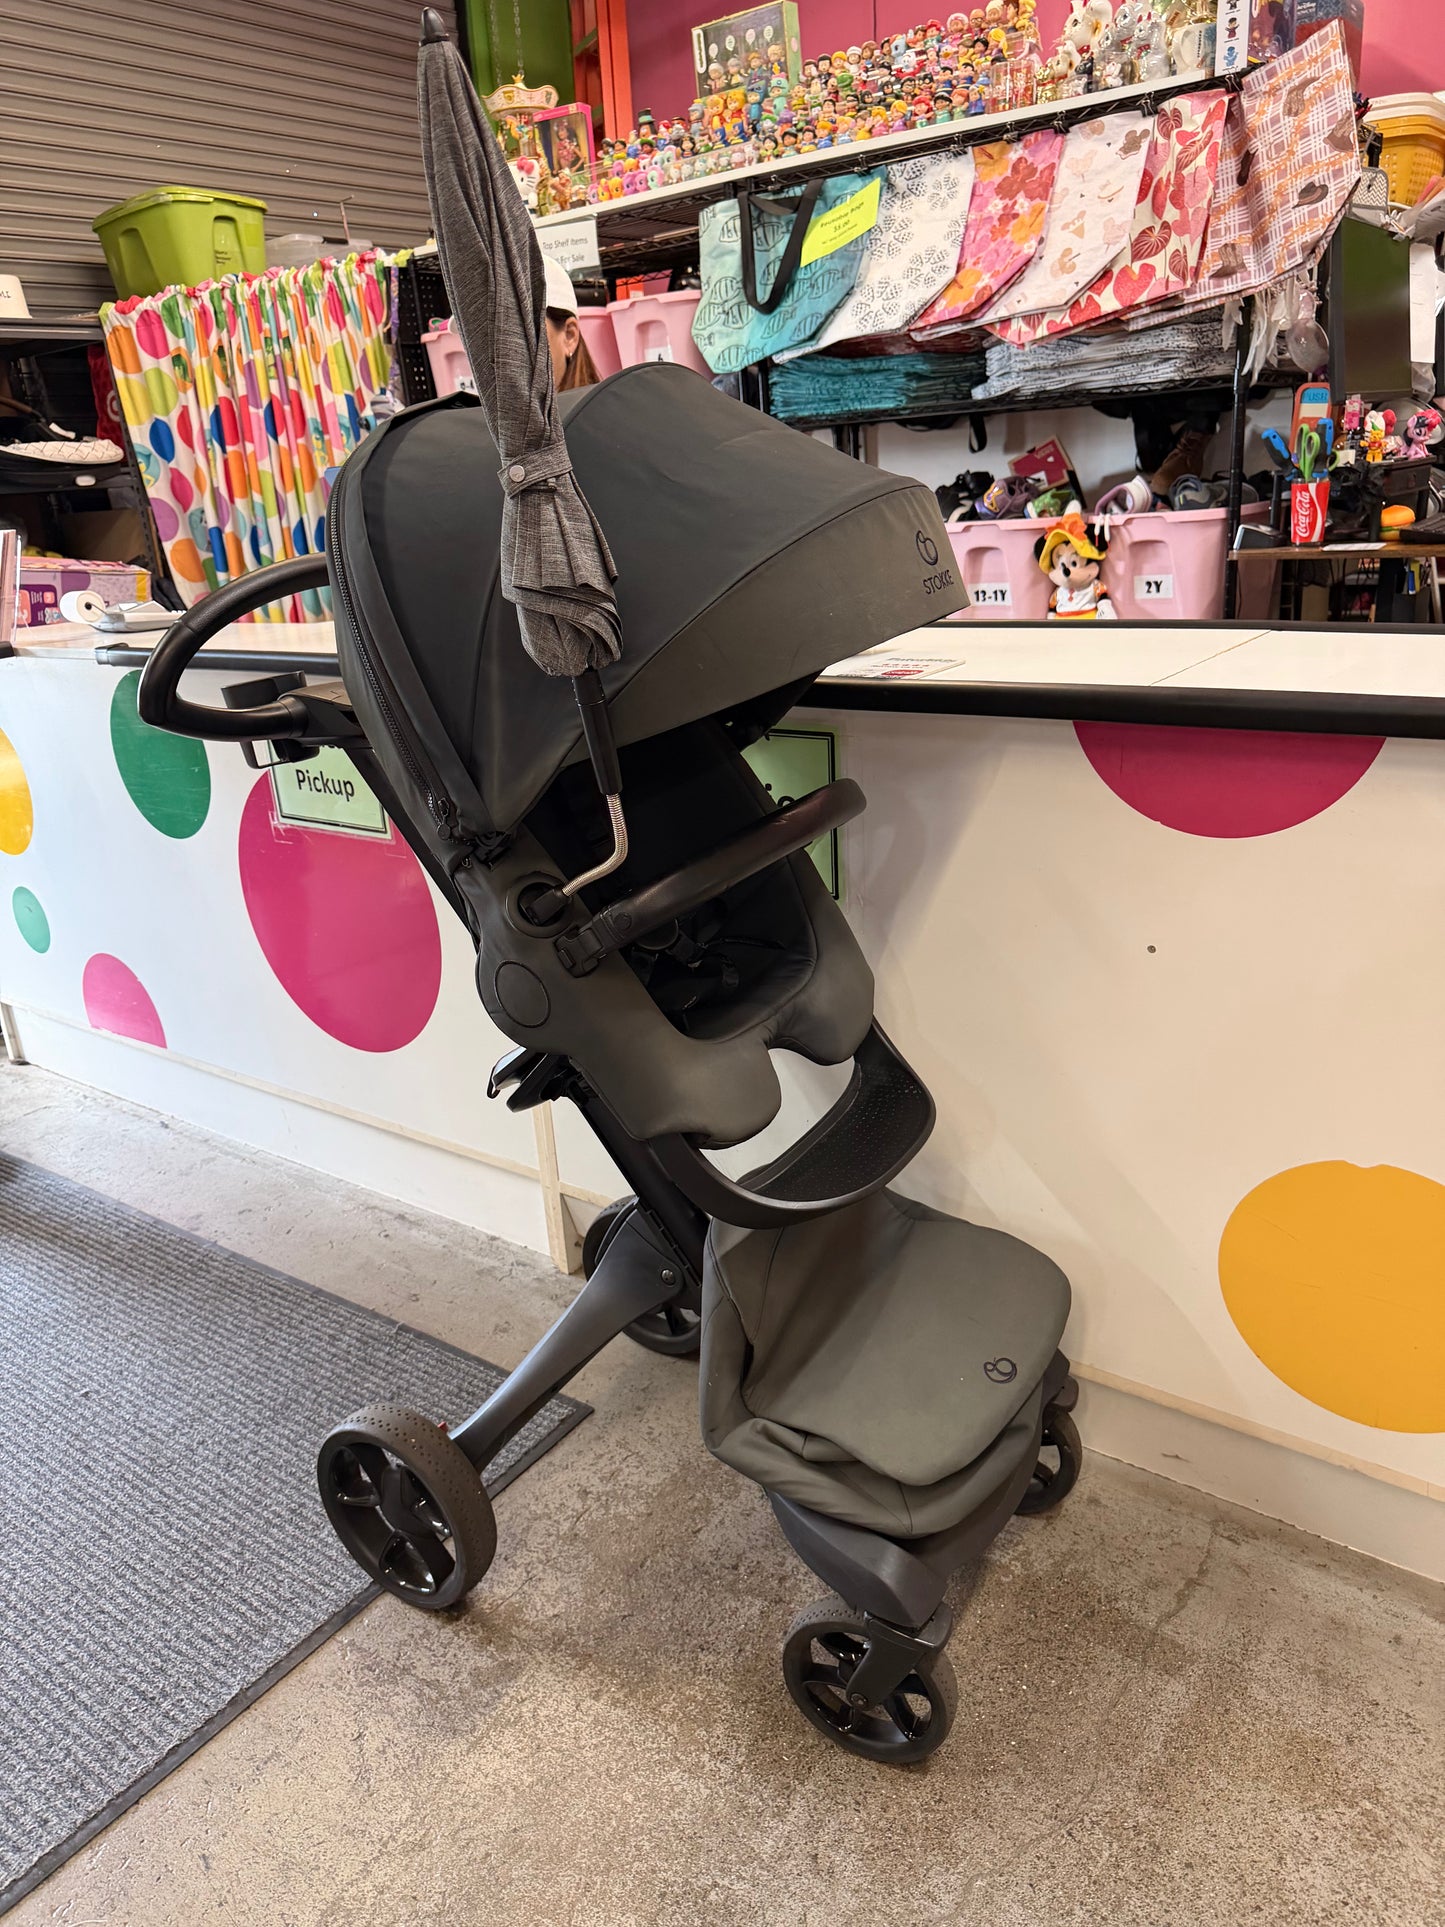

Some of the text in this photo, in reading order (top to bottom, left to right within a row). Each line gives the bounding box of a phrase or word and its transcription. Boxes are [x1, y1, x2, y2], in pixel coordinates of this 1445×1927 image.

[554, 239, 569, 248] Shelf
[572, 254, 584, 263] Sale
[922, 569, 954, 595] STOKKE
[1145, 580, 1163, 594] 2Y
[974, 589, 1007, 603] 13-1Y
[295, 769, 354, 802] Pickup
